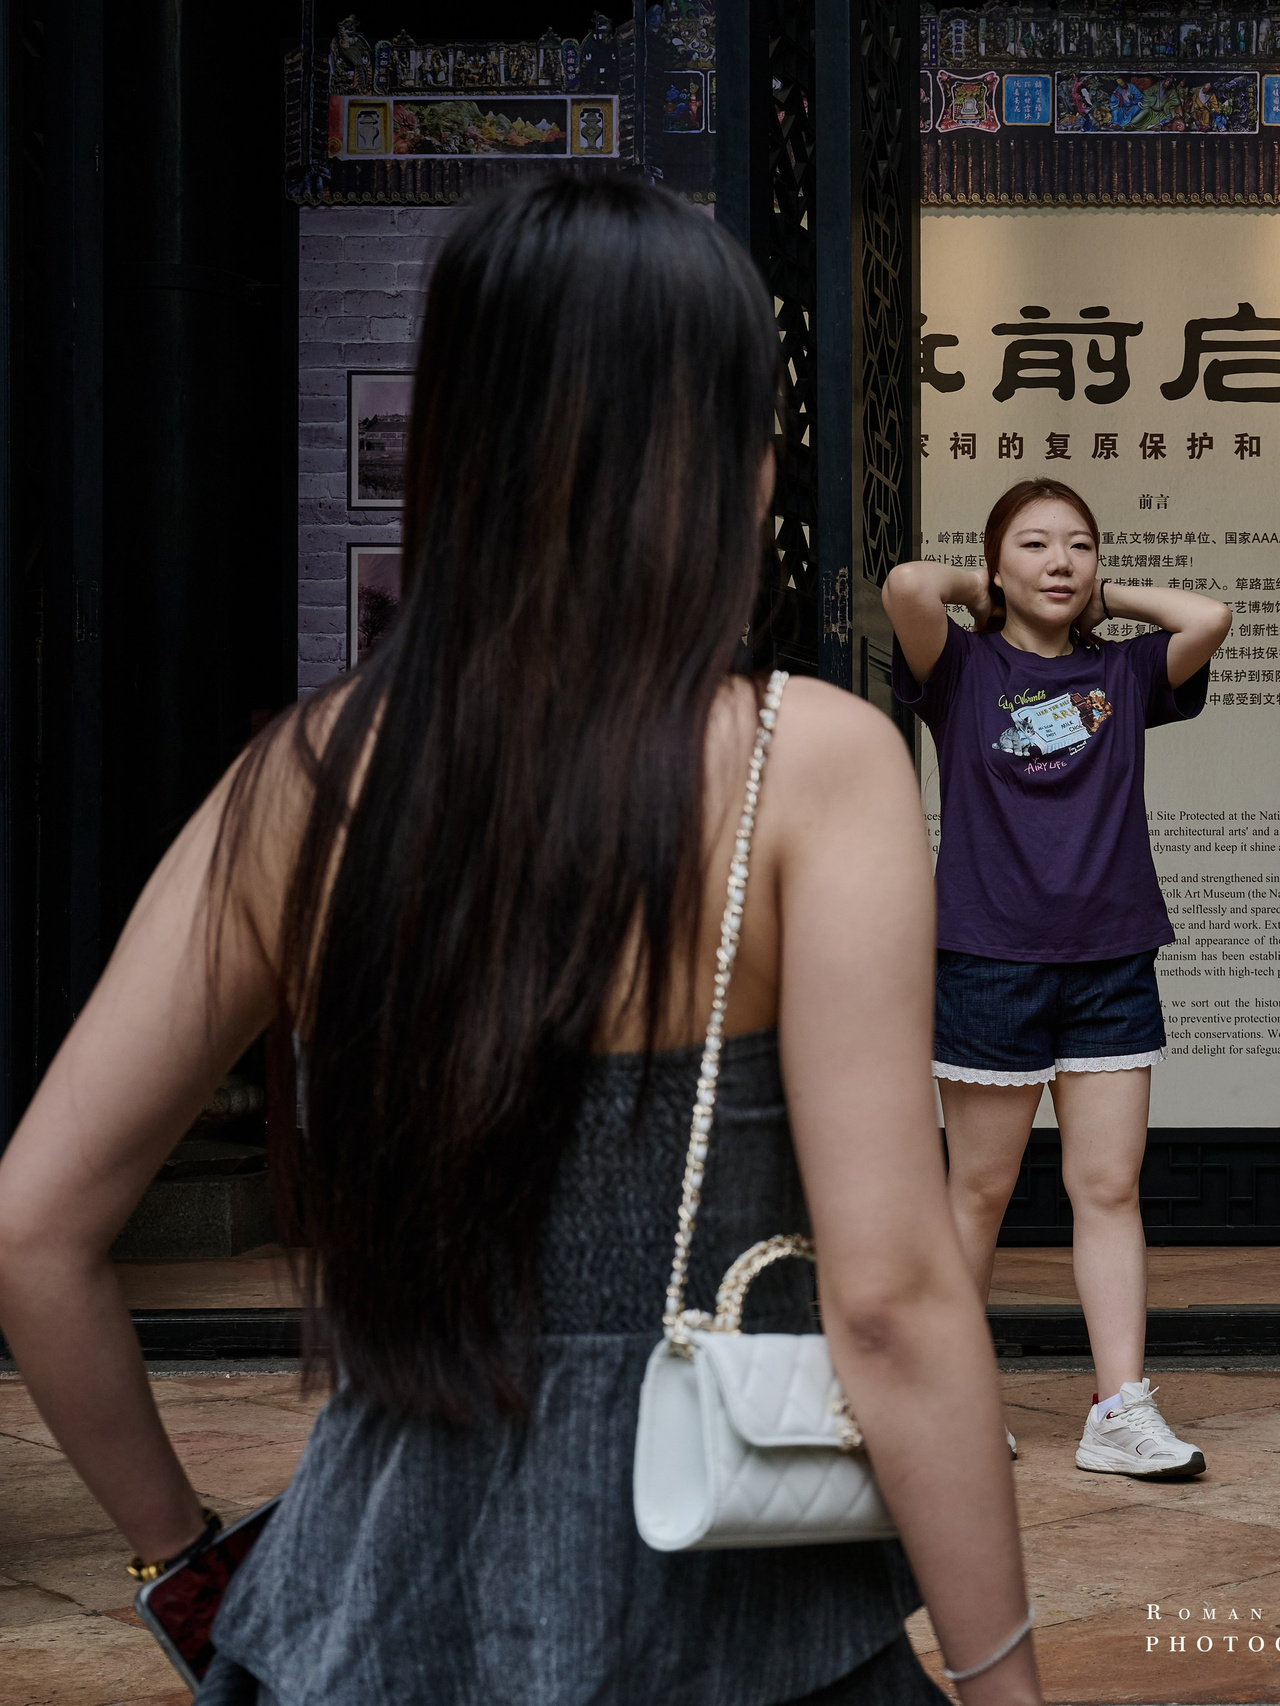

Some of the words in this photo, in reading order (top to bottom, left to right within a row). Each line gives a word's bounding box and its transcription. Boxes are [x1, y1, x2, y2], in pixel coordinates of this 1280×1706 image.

[1138, 493, 1170, 511] 前言
[921, 531, 986, 545] ，岭南建
[1156, 810, 1176, 820] Site
[1179, 810, 1226, 820] Protected
[1228, 812, 1238, 820] at
[1240, 810, 1256, 820] the
[1163, 826, 1225, 836] architectural
[1228, 826, 1249, 836] arts'
[1252, 826, 1270, 836] and
[1153, 842, 1192, 854] dynasty
[1194, 842, 1212, 852] and
[1214, 842, 1238, 854] keep
[1240, 842, 1247, 852] it
[1250, 842, 1276, 852] shine
[1180, 873, 1199, 883] and
[1201, 873, 1263, 886] strengthened
[1162, 888, 1182, 898] Folk
[1184, 888, 1201, 898] Art
[1202, 888, 1246, 898] Museum
[1247, 888, 1267, 901] (the
[1182, 904, 1227, 916] selflessly
[1230, 904, 1248, 914] and
[1188, 920, 1206, 930] and
[1208, 920, 1231, 930] hard
[1233, 920, 1261, 930] work.
[1194, 938, 1250, 948] appearance
[1254, 935, 1266, 945] of
[1201, 951, 1218, 961] has
[1222, 951, 1245, 961] been
[1160, 966, 1202, 976] methods
[1204, 966, 1226, 976] with
[1228, 966, 1274, 979] high-tech
[1171, 1000, 1186, 1008] we
[1190, 999, 1210, 1008] sort
[1214, 999, 1230, 1008] out
[1234, 998, 1250, 1008] the
[1168, 1014, 1178, 1023] to
[1180, 1013, 1232, 1026] preventive
[1194, 1028, 1264, 1038] conservations.
[1170, 1044, 1189, 1054] and
[1191, 1044, 1226, 1057] delight
[1229, 1044, 1244, 1054] for
